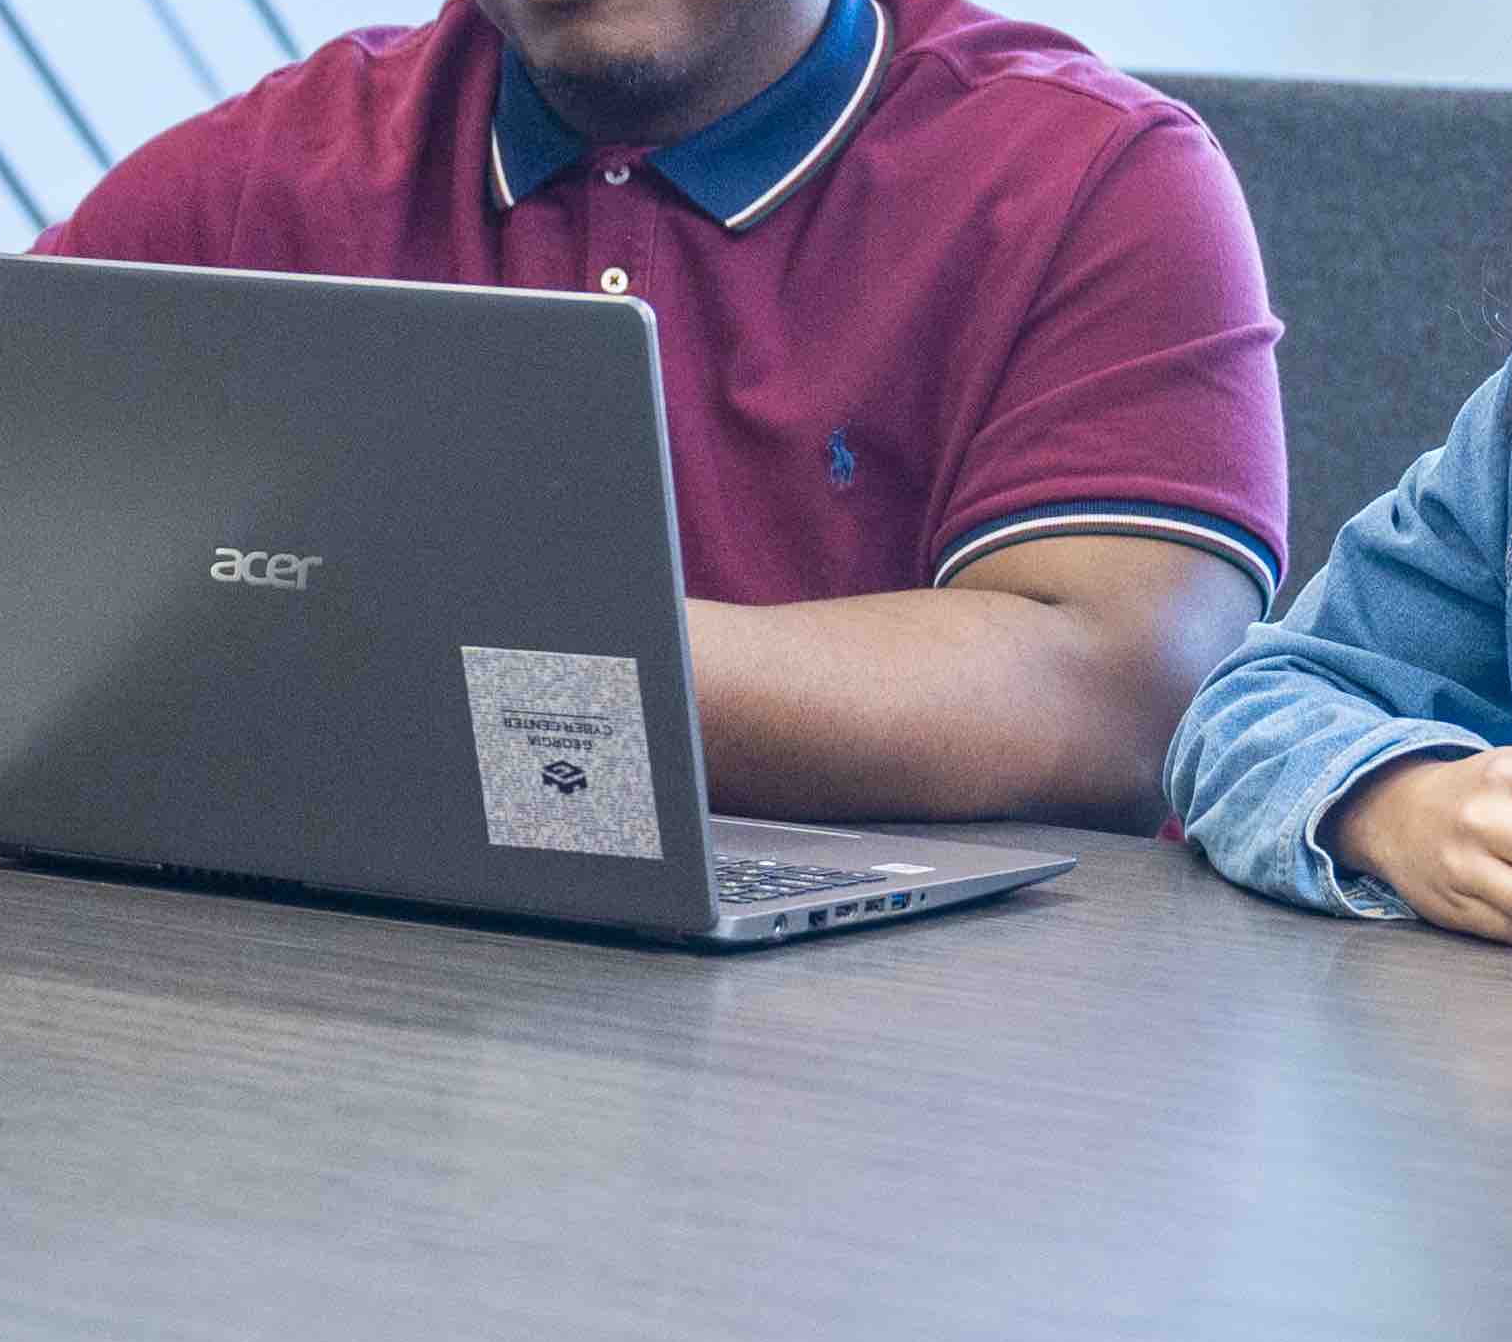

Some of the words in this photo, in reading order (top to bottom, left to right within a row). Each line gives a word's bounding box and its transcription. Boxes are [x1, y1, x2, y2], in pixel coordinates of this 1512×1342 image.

[210, 547, 323, 590] acer
[504, 717, 561, 732] CENTER
[562, 722, 613, 736] CYBER
[528, 735, 593, 750] GEORGIA
